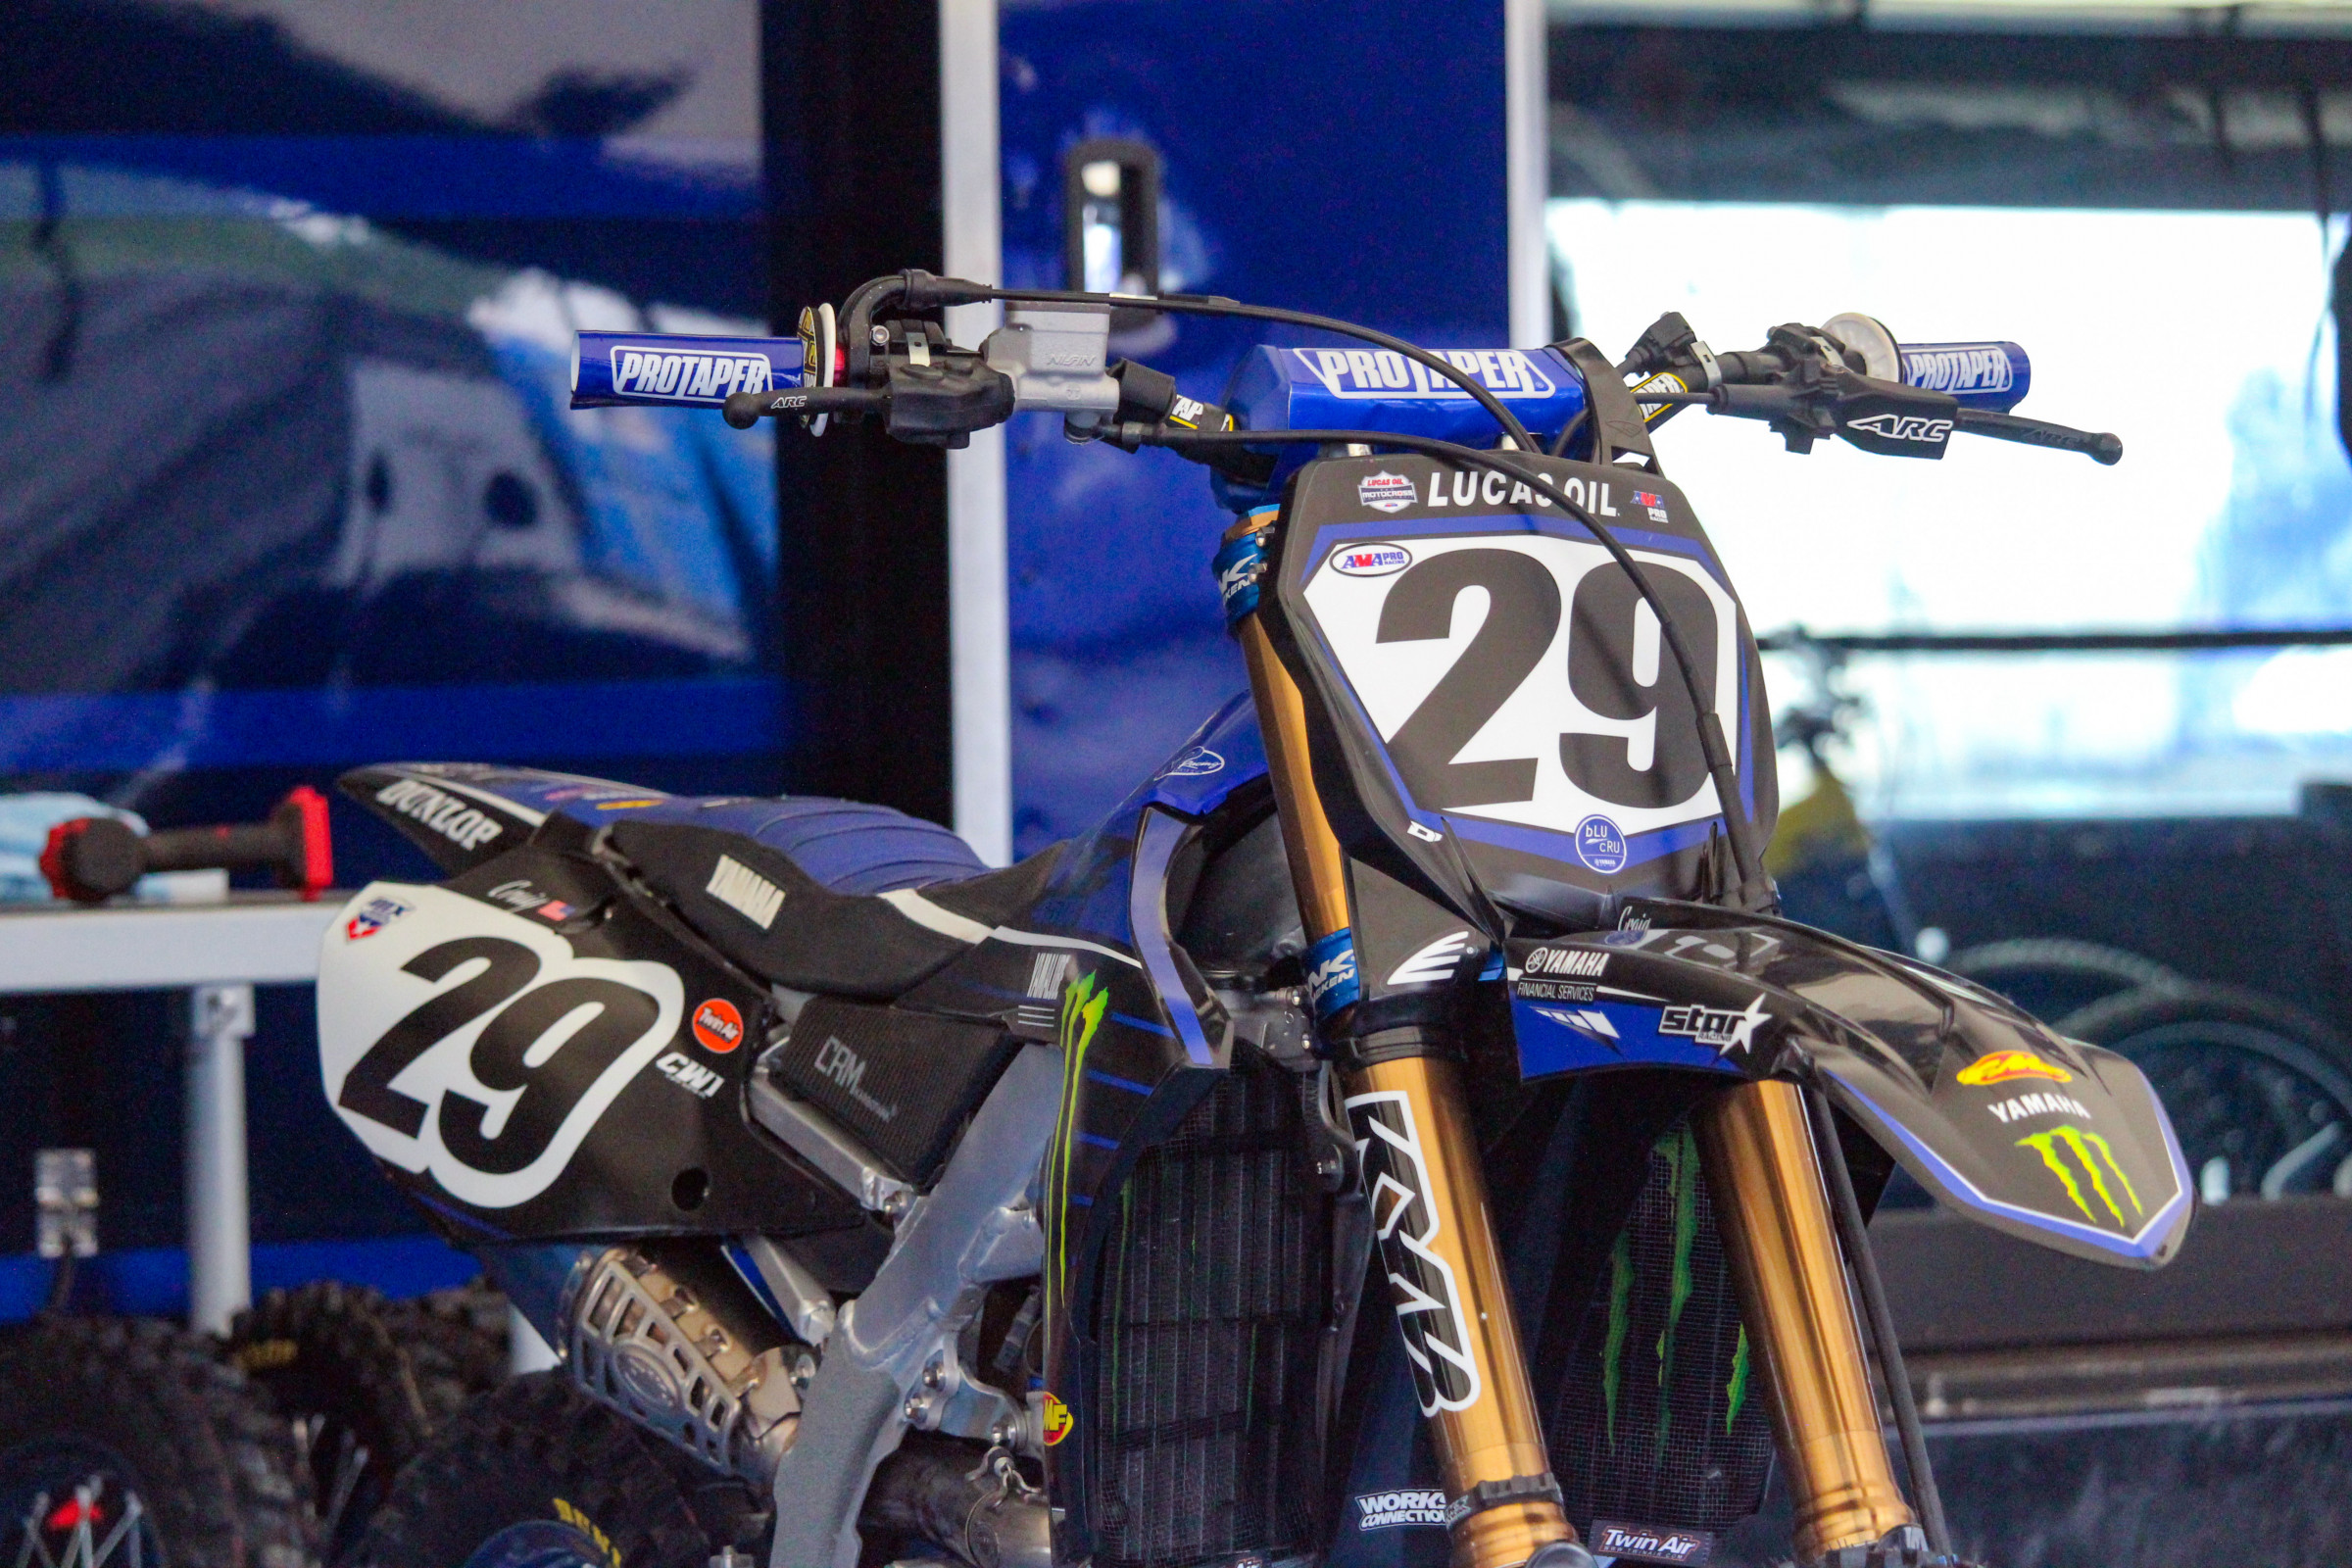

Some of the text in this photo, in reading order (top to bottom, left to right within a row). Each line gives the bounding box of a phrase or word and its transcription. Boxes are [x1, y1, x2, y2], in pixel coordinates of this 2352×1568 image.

[618, 352, 767, 403] PROTAPER
[1316, 350, 1537, 394] PROTAPER
[1905, 350, 2008, 392] PROTAPER
[771, 396, 807, 409] ARC
[1846, 413, 1953, 442] ARC
[1428, 471, 1617, 517] LUCAS OIL
[1630, 491, 1665, 509] AMA
[1341, 552, 1404, 568] AMA PRO
[1376, 548, 1719, 808] 29
[376, 779, 503, 851] DUNLOP
[1544, 949, 1609, 977] YAMAHA
[1517, 982, 1594, 1002] FINANCIAL SERVICES
[338, 937, 661, 1175] 29
[1986, 1092, 2091, 1123] YAMAHA
[1044, 1398, 1067, 1431] MF
[1605, 1529, 1696, 1555] Twin Air
